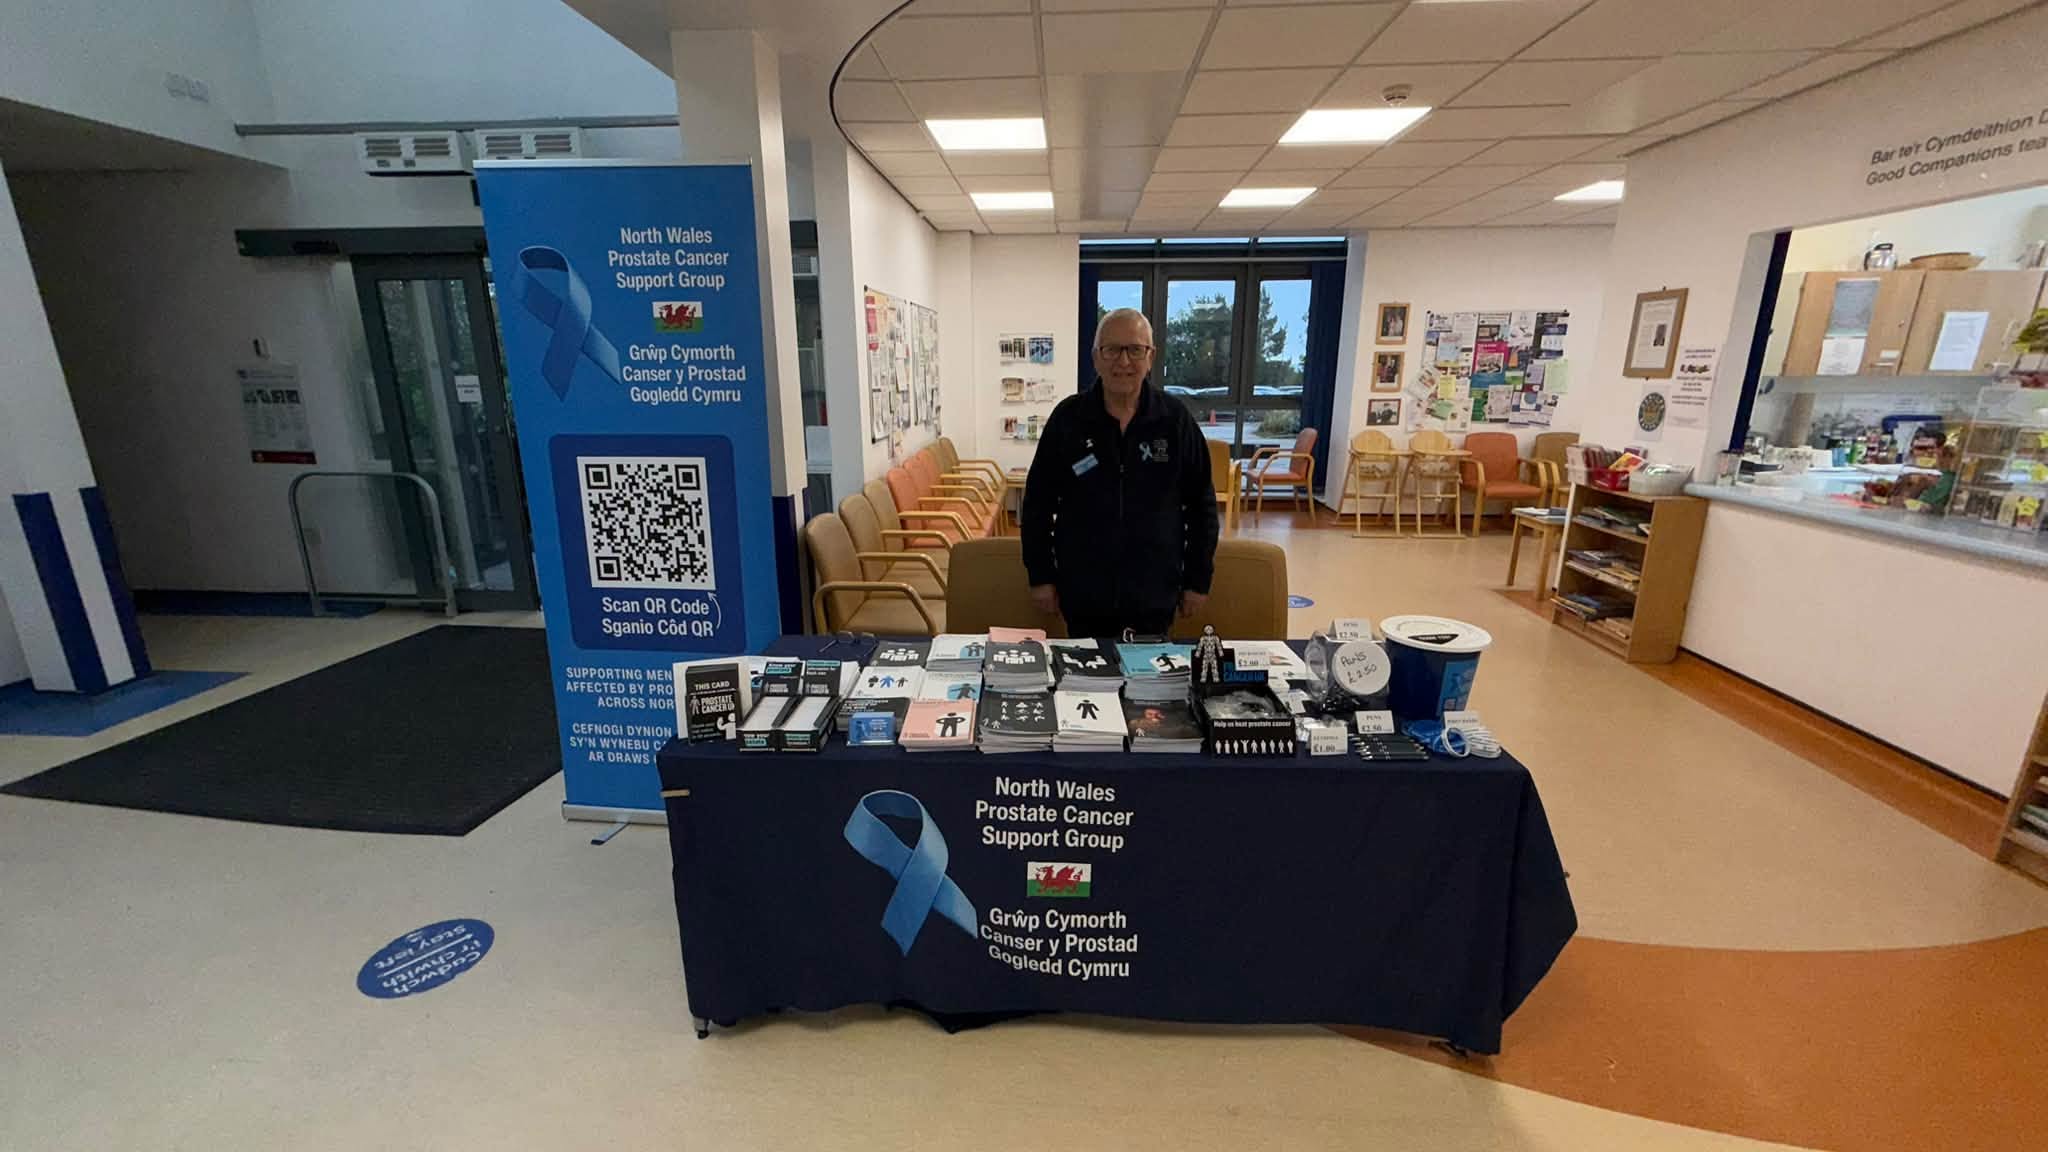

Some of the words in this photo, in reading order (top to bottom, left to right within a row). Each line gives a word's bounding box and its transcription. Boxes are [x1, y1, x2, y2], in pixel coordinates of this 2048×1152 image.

[1871, 150, 1896, 165] Bar
[1925, 115, 2033, 153] Cymdeithion
[1866, 166, 1906, 185] Good
[1909, 143, 2013, 177] Companions
[2018, 136, 2048, 153] tea
[620, 227, 662, 244] North
[666, 227, 713, 244] Wales
[608, 250, 671, 267] Prostate
[674, 249, 729, 266] Cancer
[616, 272, 674, 292] Support
[678, 271, 725, 291] Group
[629, 344, 668, 364] Grŵp
[671, 344, 735, 364] Cymorth
[622, 366, 672, 382] Canser
[675, 369, 684, 384] y
[688, 365, 746, 381] Prostad
[630, 386, 688, 405] Gogledd
[692, 386, 741, 405] Cymru
[602, 597, 640, 614] Scan
[644, 598, 667, 614] QR
[671, 598, 710, 615] Code
[602, 618, 654, 637] Sganio
[658, 617, 687, 636] Côd
[691, 620, 714, 637] QR
[566, 667, 643, 680] SUPPORTING
[646, 670, 673, 681] MEN
[566, 682, 625, 694] AFFECTED
[629, 684, 645, 695] BY
[695, 683, 710, 691] THIS
[711, 681, 730, 689] CARD
[597, 696, 646, 709] ACROSS
[701, 695, 733, 705] PROSTATE
[702, 703, 727, 714] CANCER
[572, 723, 623, 735] CEFNOGI
[627, 725, 672, 737] DYNION
[569, 737, 596, 748] SY'N
[600, 739, 650, 751] WYNEBU
[589, 751, 604, 762] AR
[607, 752, 650, 764] DRAWS
[995, 776, 1050, 798] North
[1056, 780, 1116, 802] Wales
[975, 800, 1057, 822] Prostate
[1063, 805, 1134, 826] Cancer
[982, 826, 1060, 851] Support
[1065, 829, 1125, 853] Group
[989, 907, 1040, 931] Grŵp
[1045, 909, 1127, 932] Cymorth
[980, 925, 1044, 952] Canser
[1049, 936, 1060, 957] y
[1065, 934, 1138, 954] Prostad
[394, 951, 481, 993] Cadwch
[988, 945, 1062, 976] Gogledd
[1068, 958, 1130, 981] Cymru
